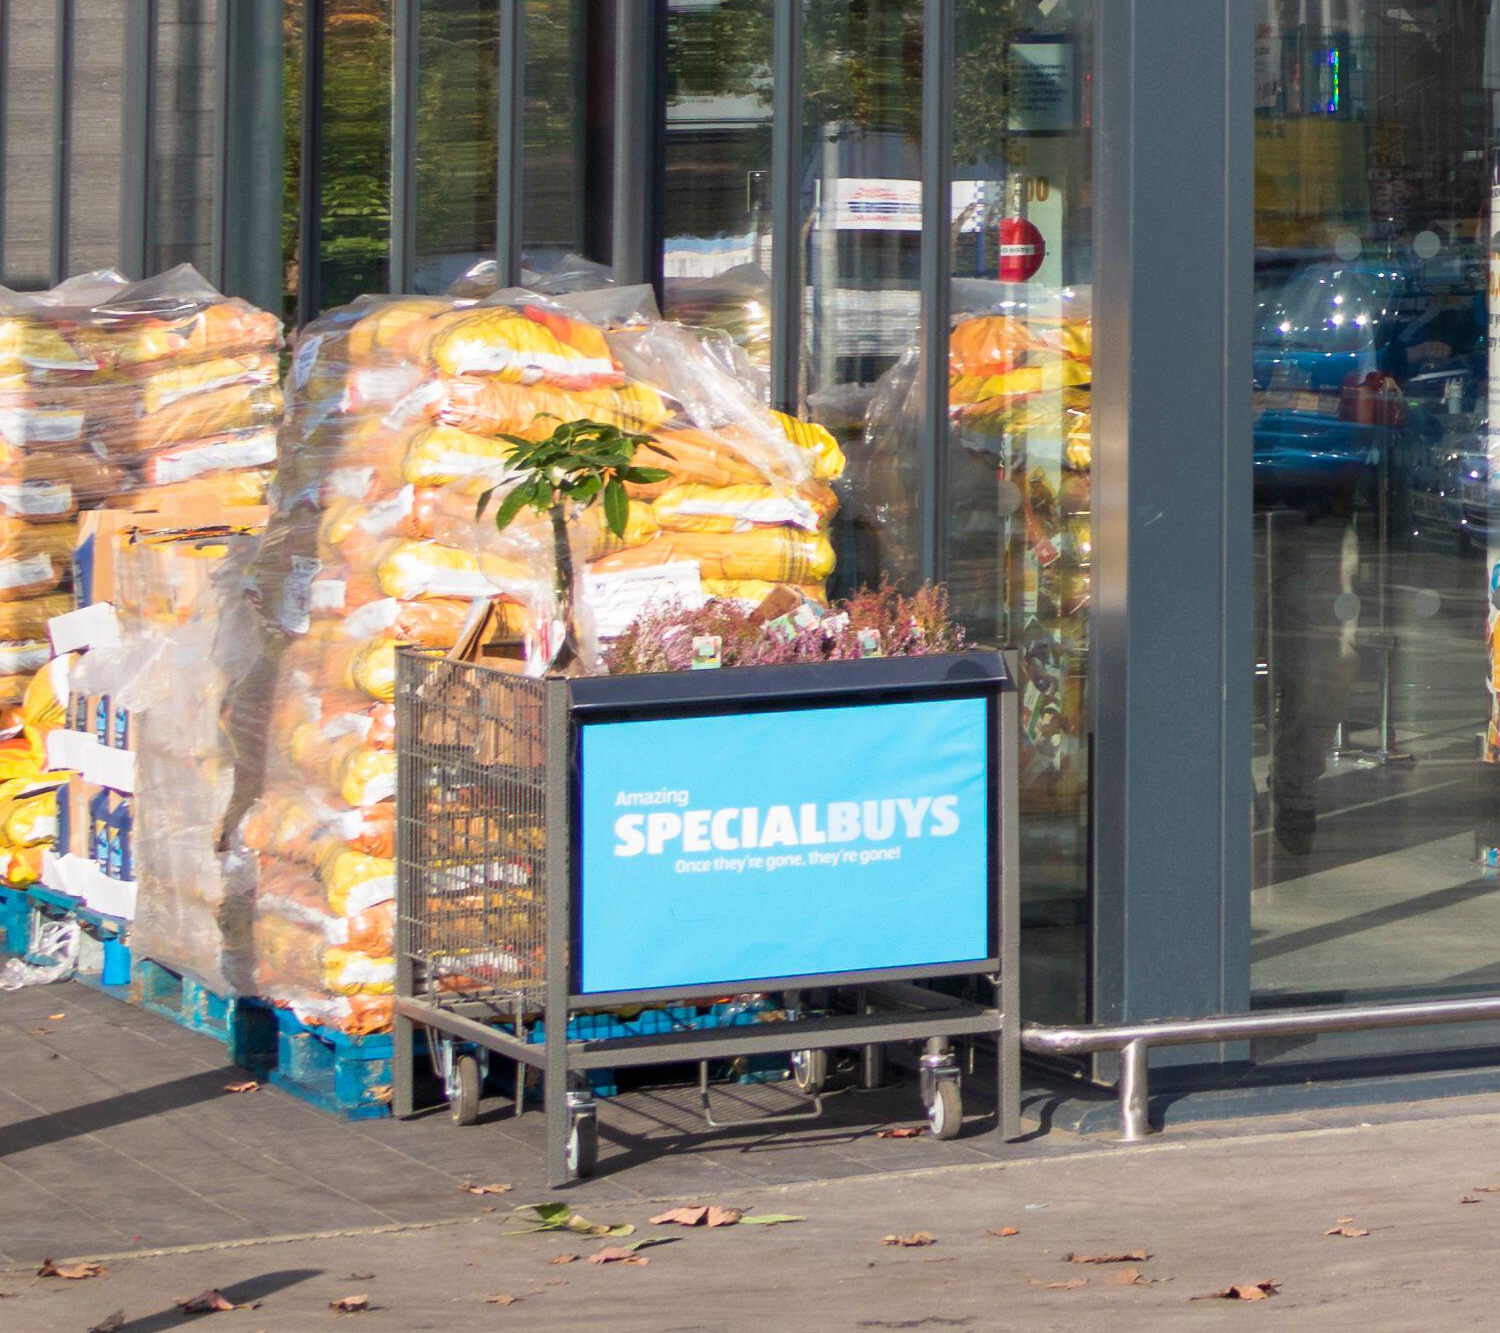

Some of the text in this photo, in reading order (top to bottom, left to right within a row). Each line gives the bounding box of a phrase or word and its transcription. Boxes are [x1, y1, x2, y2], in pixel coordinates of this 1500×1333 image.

[614, 786, 690, 808] Amazing
[613, 795, 961, 857] SPECIALBUYS
[674, 858, 711, 874] Once
[714, 854, 763, 874] they're
[808, 848, 858, 867] they're
[860, 846, 902, 865] gone!
